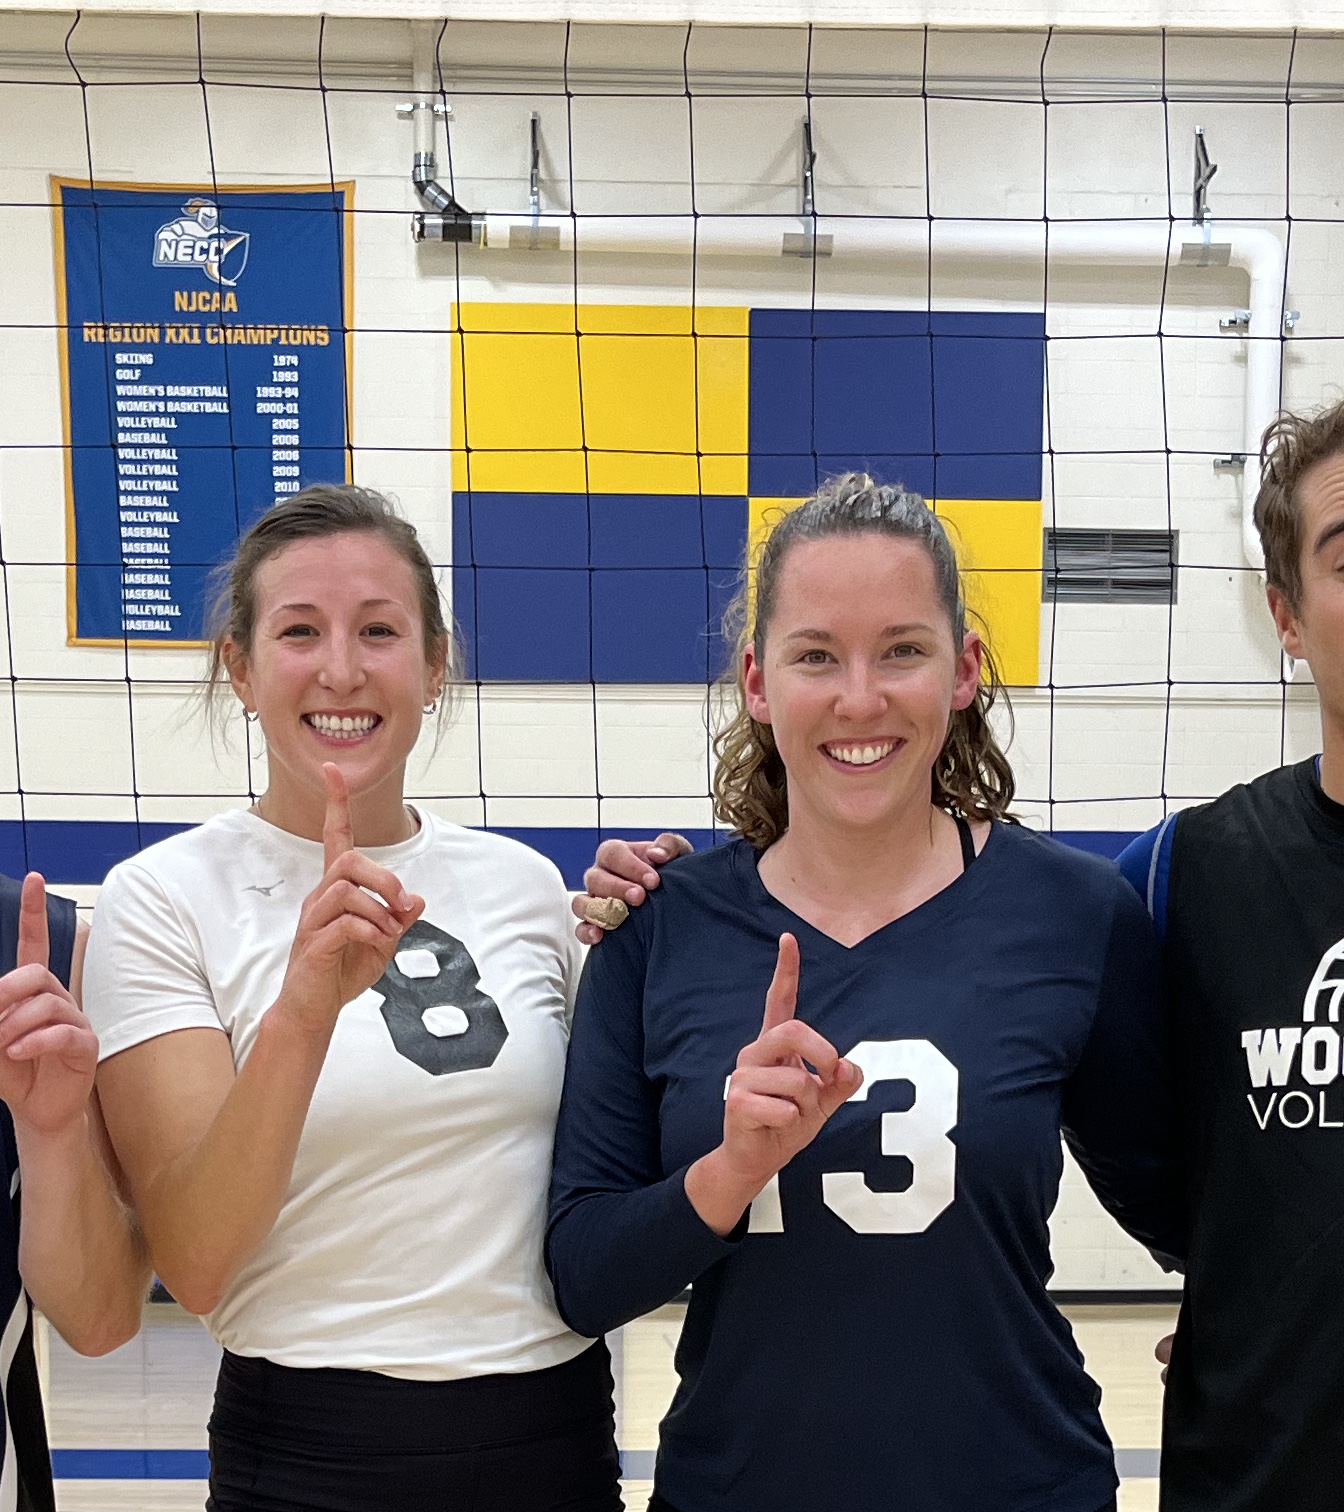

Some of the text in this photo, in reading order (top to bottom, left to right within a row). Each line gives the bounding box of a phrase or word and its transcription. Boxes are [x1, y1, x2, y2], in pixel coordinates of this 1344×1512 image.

[158, 239, 225, 263] NECC
[174, 290, 238, 313] NJCAA
[83, 321, 330, 346] REGION XXI CHAMPIONS
[114, 352, 299, 367] SKIING 1974
[115, 368, 299, 383] GOLF 1993
[115, 384, 165, 398] WOMEN'S
[166, 384, 229, 398] BASKETBALL
[116, 400, 166, 413] WOMEN'S
[167, 400, 230, 414] BASKETBALL
[117, 416, 178, 430] VOLLEYBALL
[117, 432, 168, 445] BASEBALL
[117, 447, 178, 461] VOLLEYBALL
[118, 463, 179, 476] VOLLEYBALL
[118, 479, 179, 492] VOLLEYBALL
[119, 495, 169, 508] BASEBALL
[119, 510, 180, 524] VOLLEYBALL
[120, 526, 171, 539] BASEBALL
[121, 542, 171, 554] BASEBALL
[371, 918, 510, 1077] 8
